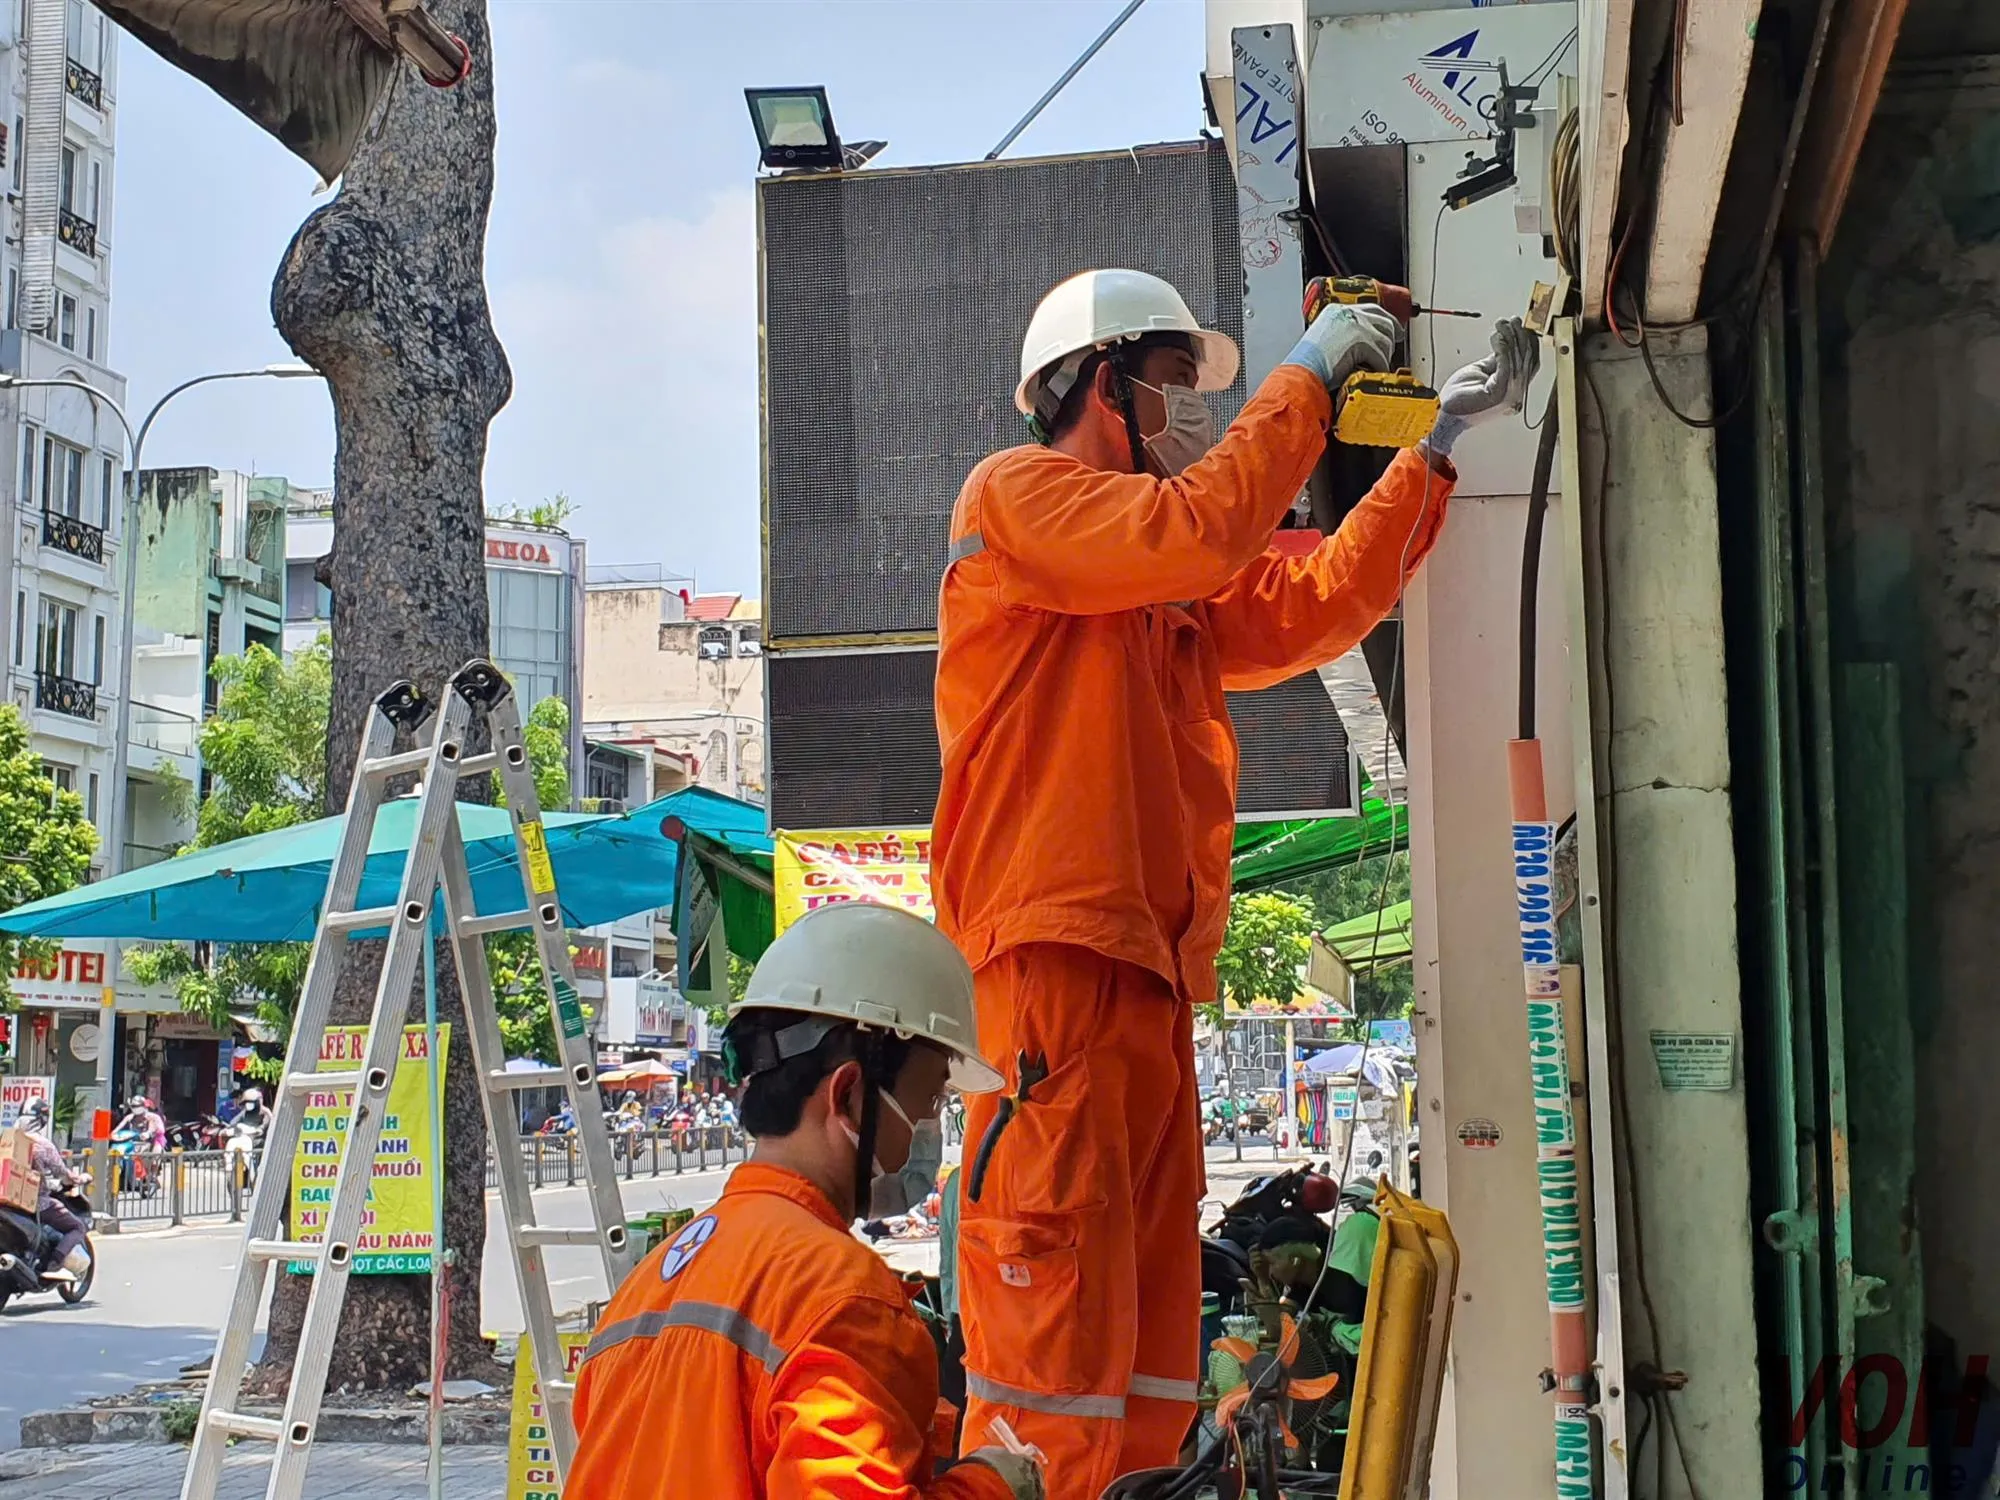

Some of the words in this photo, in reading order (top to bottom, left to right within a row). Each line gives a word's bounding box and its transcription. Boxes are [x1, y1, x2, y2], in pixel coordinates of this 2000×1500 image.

[1402, 72, 1468, 132] Aluminum
[1361, 109, 1388, 134] ISO
[797, 833, 905, 865] CAFÉ
[357, 1232, 382, 1252] ẬU
